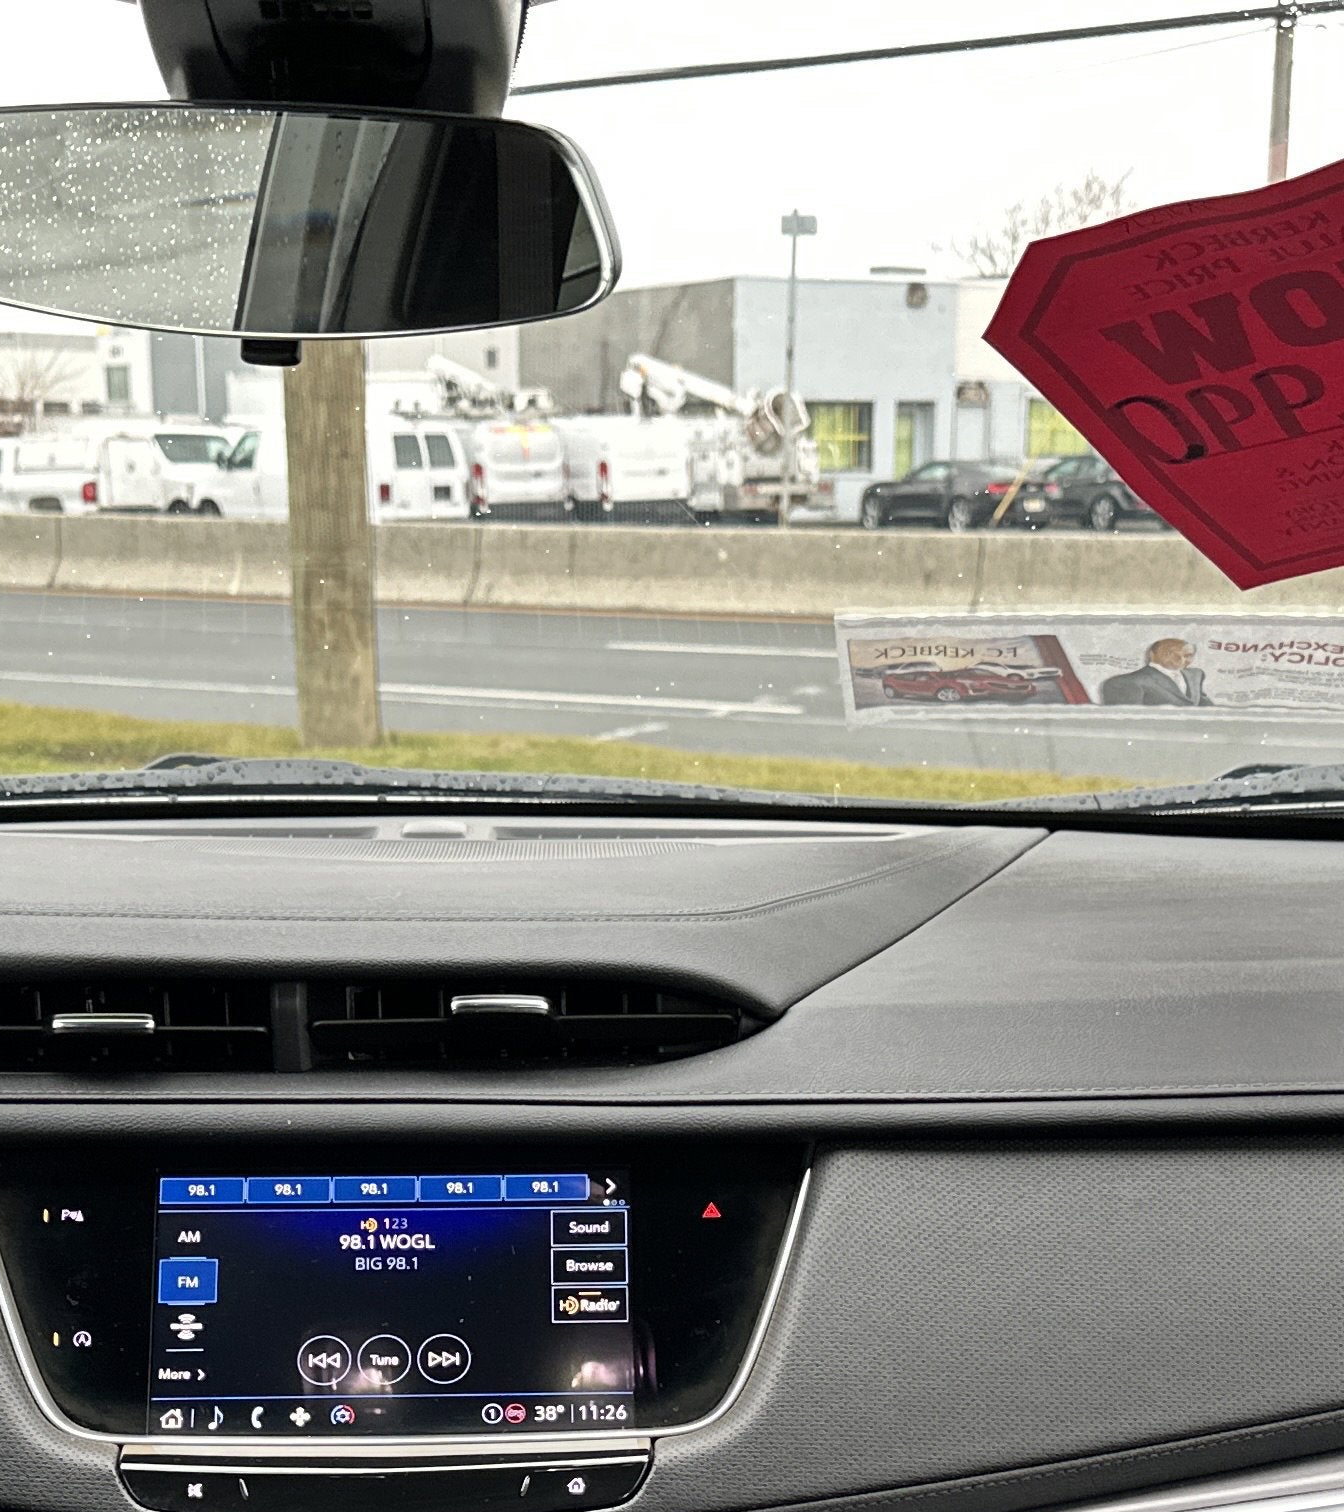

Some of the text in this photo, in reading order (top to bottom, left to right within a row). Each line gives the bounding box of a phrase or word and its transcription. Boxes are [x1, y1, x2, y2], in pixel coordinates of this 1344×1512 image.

[188, 1183, 216, 1196] 98.1
[274, 1183, 302, 1196] 98.1
[360, 1182, 388, 1195] 98.1
[446, 1181, 474, 1194] 98.1
[531, 1180, 559, 1193] 98.1
[569, 1221, 609, 1234] Sound
[177, 1230, 201, 1244] AM
[339, 1233, 436, 1250] 98.1 WOGL
[355, 1256, 418, 1271] BIG 98.1
[566, 1259, 614, 1272] Browse
[177, 1276, 199, 1289] FM
[369, 1353, 399, 1366] Tune
[158, 1368, 191, 1381] More
[534, 1404, 565, 1421] 38°
[578, 1404, 627, 1421] 11:26
